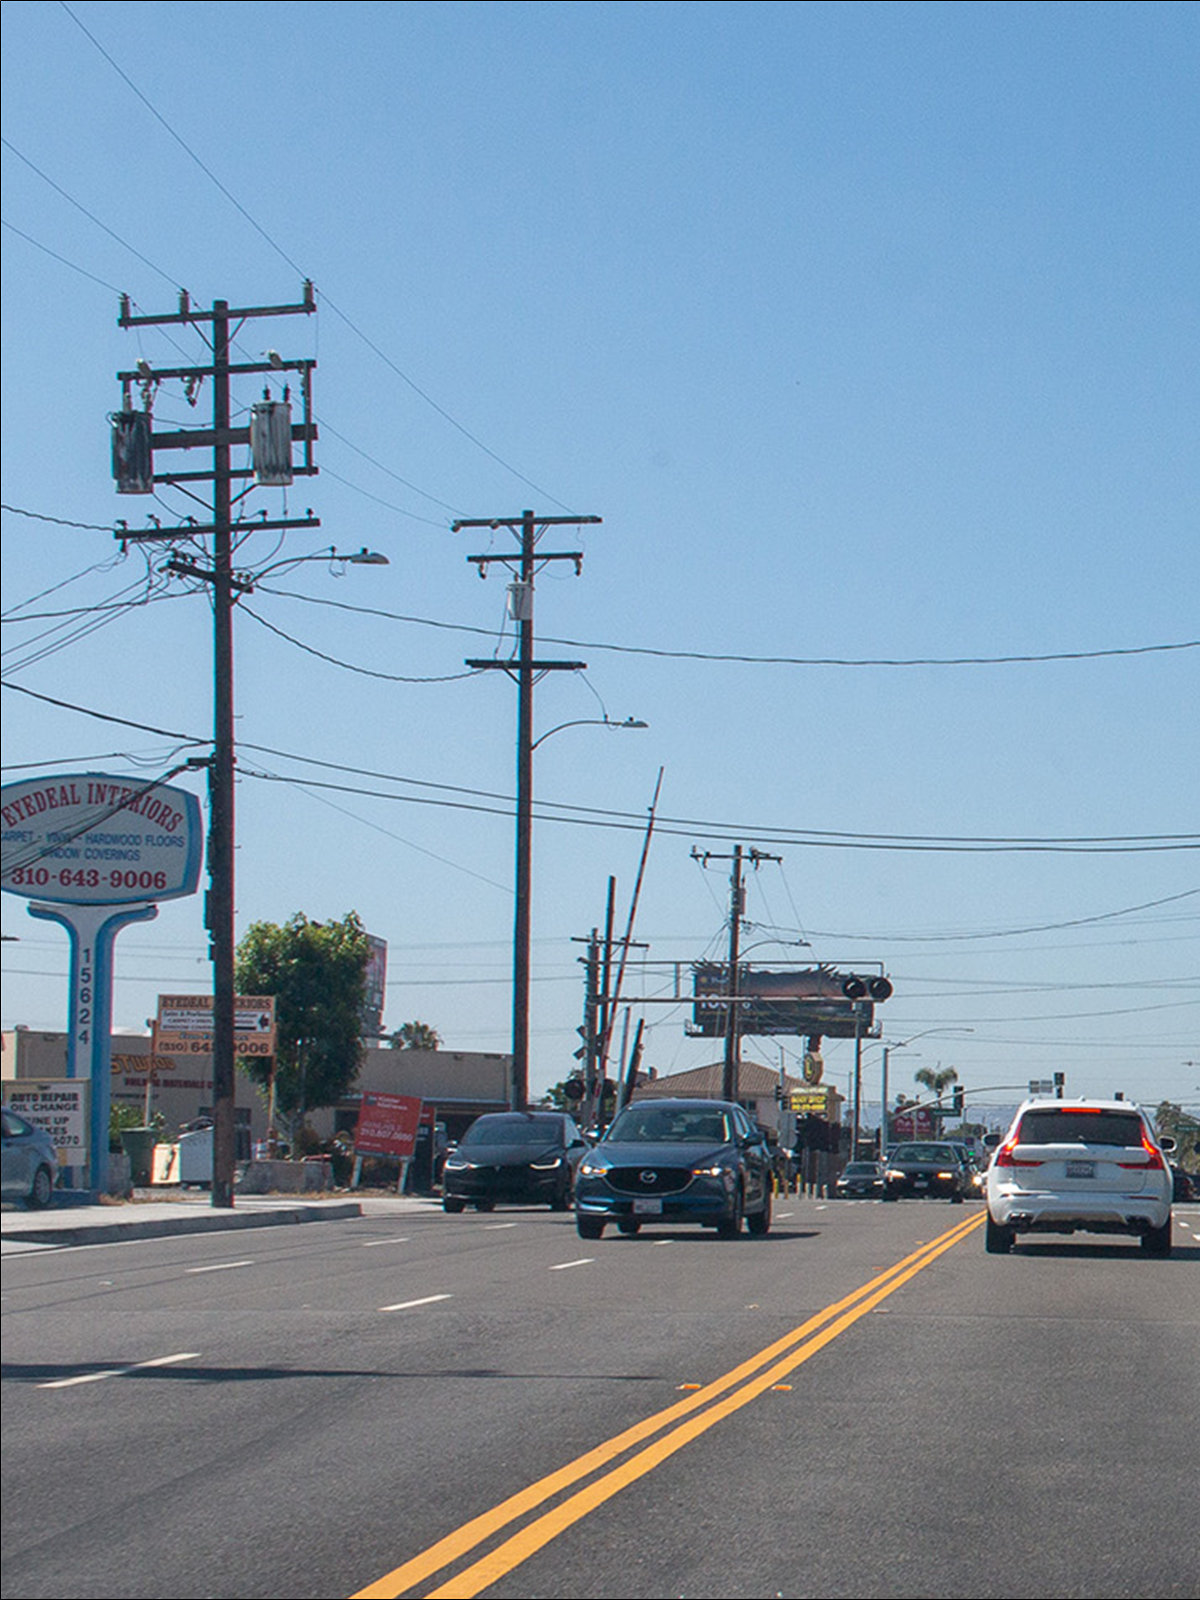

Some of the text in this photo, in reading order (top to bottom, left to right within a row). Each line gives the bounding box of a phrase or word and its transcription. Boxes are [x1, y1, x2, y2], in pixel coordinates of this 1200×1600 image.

[2, 783, 184, 833] EYEDEAL INTERIORS
[85, 833, 142, 846] HARDWOOD
[145, 835, 186, 848] FLOORS
[84, 849, 141, 861] COVERINGS
[11, 867, 167, 890] 310-643-9006
[11, 1093, 78, 1102] AUTO REPAIR
[11, 1103, 79, 1111] OIL CHANGE
[26, 1117, 69, 1125] UNE UP
